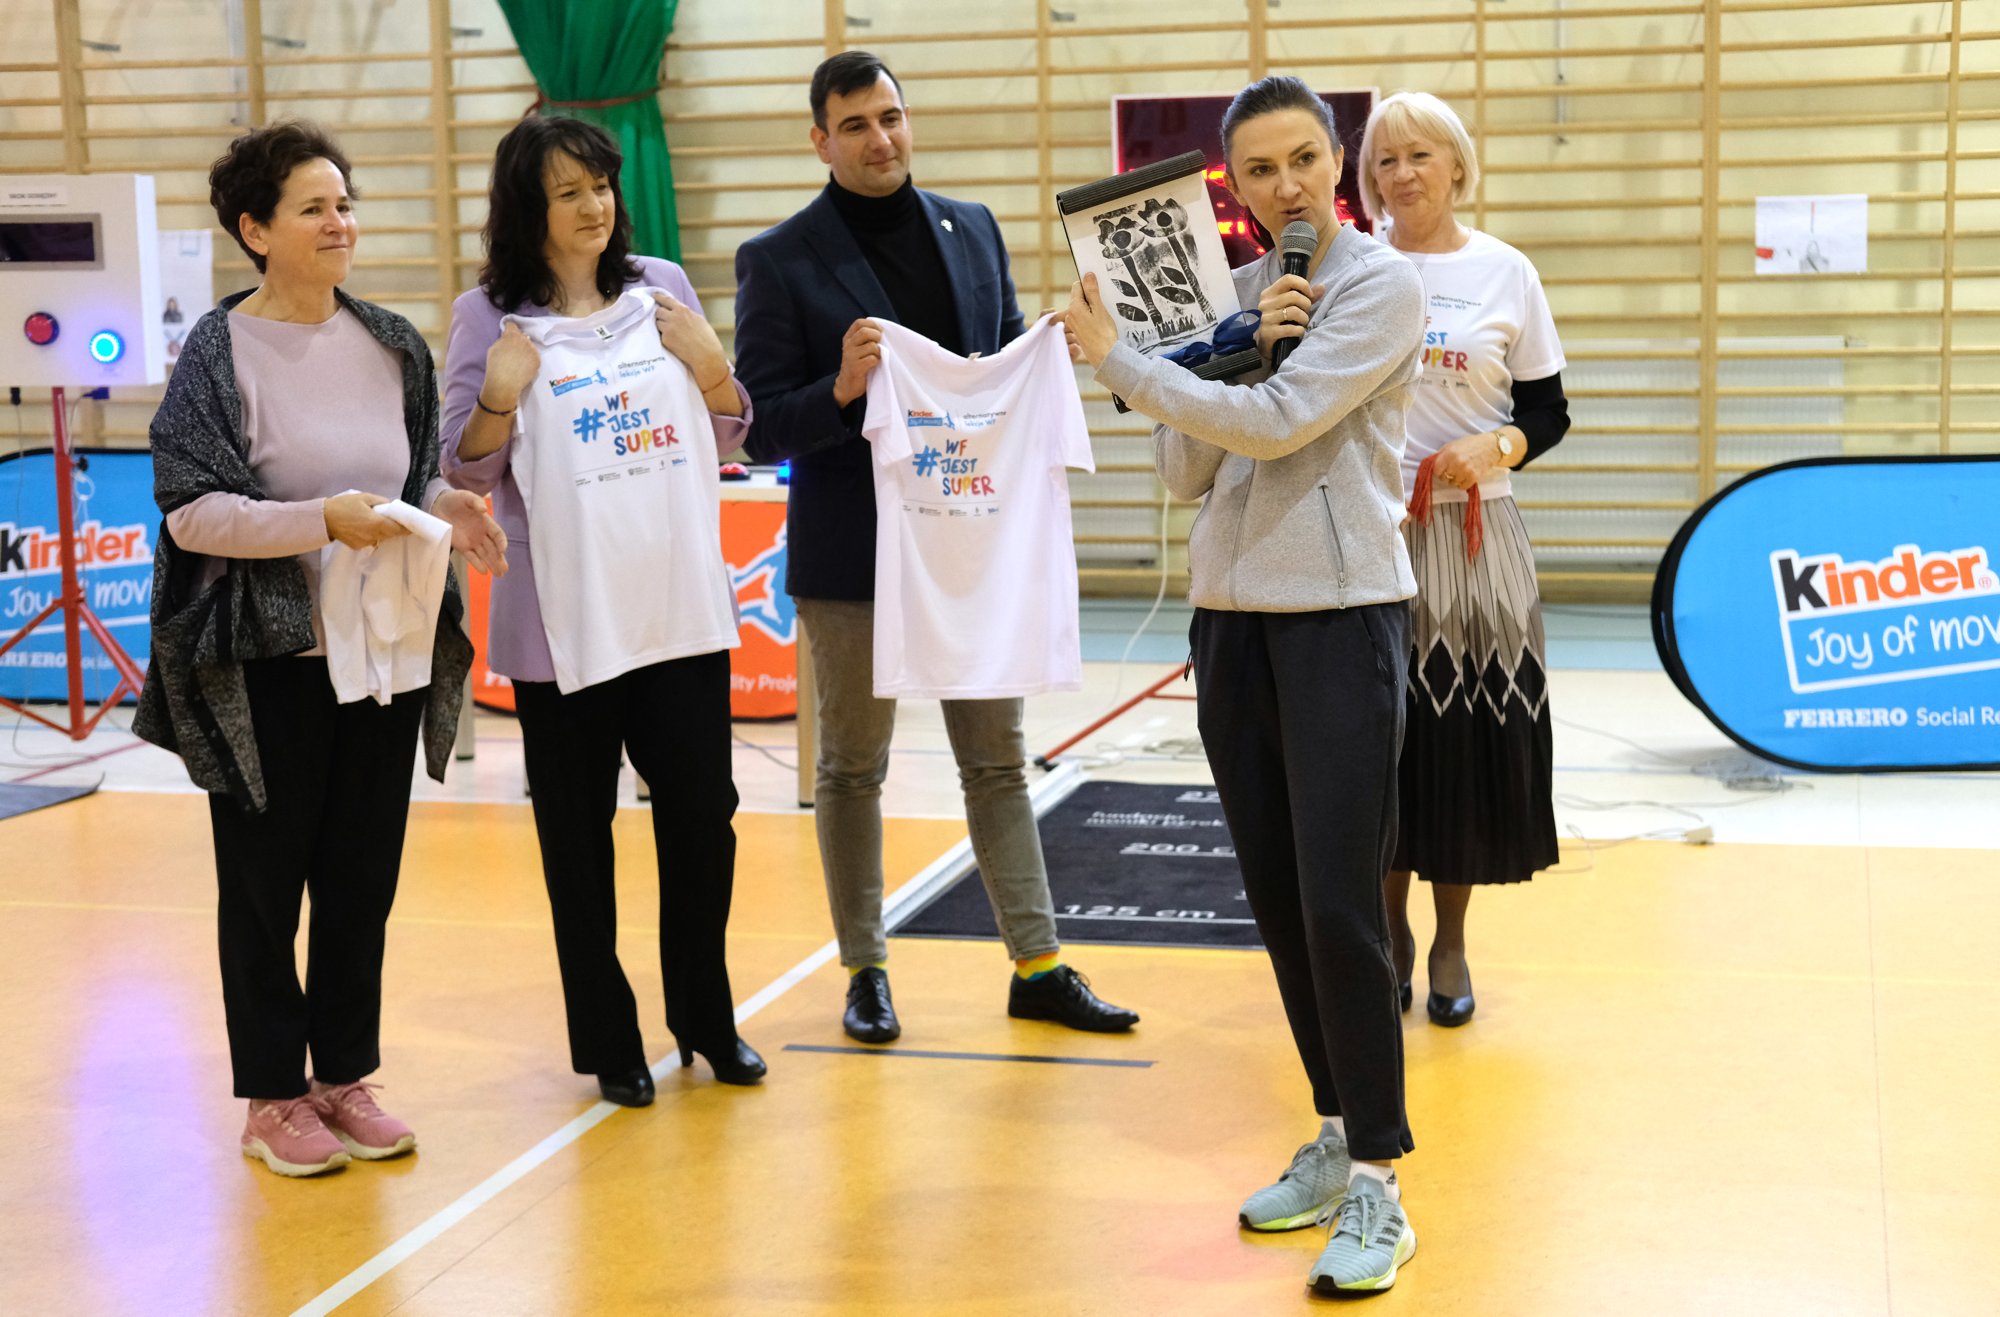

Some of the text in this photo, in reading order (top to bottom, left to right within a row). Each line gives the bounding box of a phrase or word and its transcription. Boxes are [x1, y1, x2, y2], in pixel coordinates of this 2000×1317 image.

[604, 390, 630, 411] WF
[607, 408, 650, 433] JEST
[613, 424, 680, 456] SUPER
[945, 438, 968, 457] WF
[940, 458, 978, 474] JEST
[942, 475, 995, 497] SUPER
[1778, 552, 1981, 611] kinder
[1805, 627, 1874, 670] Joy
[1882, 614, 1919, 657] of
[1784, 708, 1907, 728] FERRERO
[1916, 707, 1975, 727] Social
[1064, 904, 1216, 919] 125 cm
